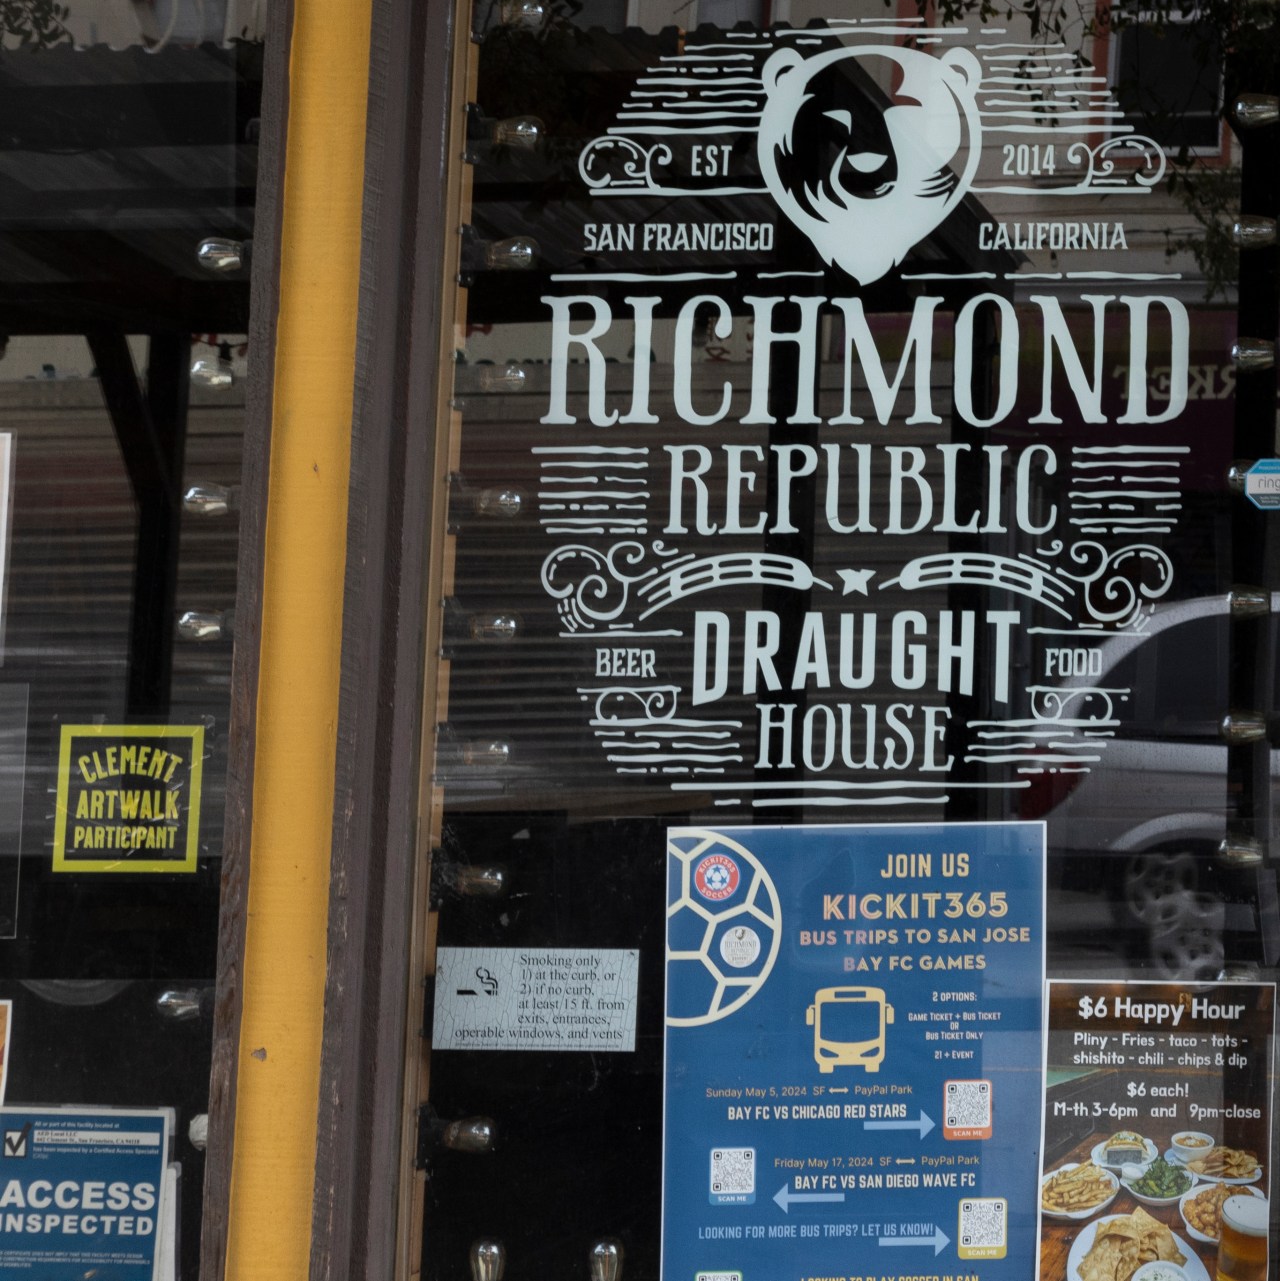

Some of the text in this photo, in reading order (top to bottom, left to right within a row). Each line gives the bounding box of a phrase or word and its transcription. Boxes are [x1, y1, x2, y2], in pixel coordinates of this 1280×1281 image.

[691, 145, 733, 177] EST
[1002, 144, 1056, 176] 2014
[583, 223, 774, 251] SAN FRANCISCO
[979, 222, 1129, 250] CALIFORNIA
[540, 293, 1191, 427] RICHMOND
[663, 443, 1058, 536] REPUBLIC
[594, 647, 656, 678] BEER
[692, 609, 1021, 706] DRAUGHT
[1044, 646, 1103, 677] FOOD
[754, 703, 954, 773] HOUSE
[78, 745, 183, 784] CLEMENT
[76, 790, 180, 819] ARTWALK
[74, 826, 177, 849] PARTICIPANT
[881, 853, 969, 878] JOIN US
[823, 892, 1008, 920] KICKIT365
[800, 928, 1030, 946] BUS TRIPS TO SAN JOSE
[520, 955, 600, 968] Smoking only
[844, 955, 986, 972] BAY FC GAMES
[522, 970, 616, 982] 1) at the curb, or
[520, 984, 594, 996] 2) if no curb,
[932, 992, 977, 1001] 2 OPTIONS:
[519, 999, 625, 1010] at least 15 ft. from
[1078, 996, 1245, 1026] $6 Happy Hour
[518, 1014, 610, 1026] exits, entrances,
[455, 1028, 623, 1041] operable windows, and vents
[1074, 1032, 1238, 1049] Pliny Fries taco tots
[1073, 1052, 1247, 1069] shishito chili chips dip
[706, 1085, 912, 1099] Sunday May 2024 SF PayPal Park
[1127, 1082, 1189, 1098] $6 each!
[728, 1104, 907, 1120] BAY FC VS CHICAGO RED STARS
[1054, 1102, 1261, 1120] M-th 3-6pm and 9pm-close
[795, 1173, 976, 1190] BAY FC VS SAN DIEGO WAVE FC
[0, 1180, 155, 1211] ACCESS
[699, 1223, 933, 1240] LOOKING FOR MORE BUS TRIPS? LET US KNOW!
